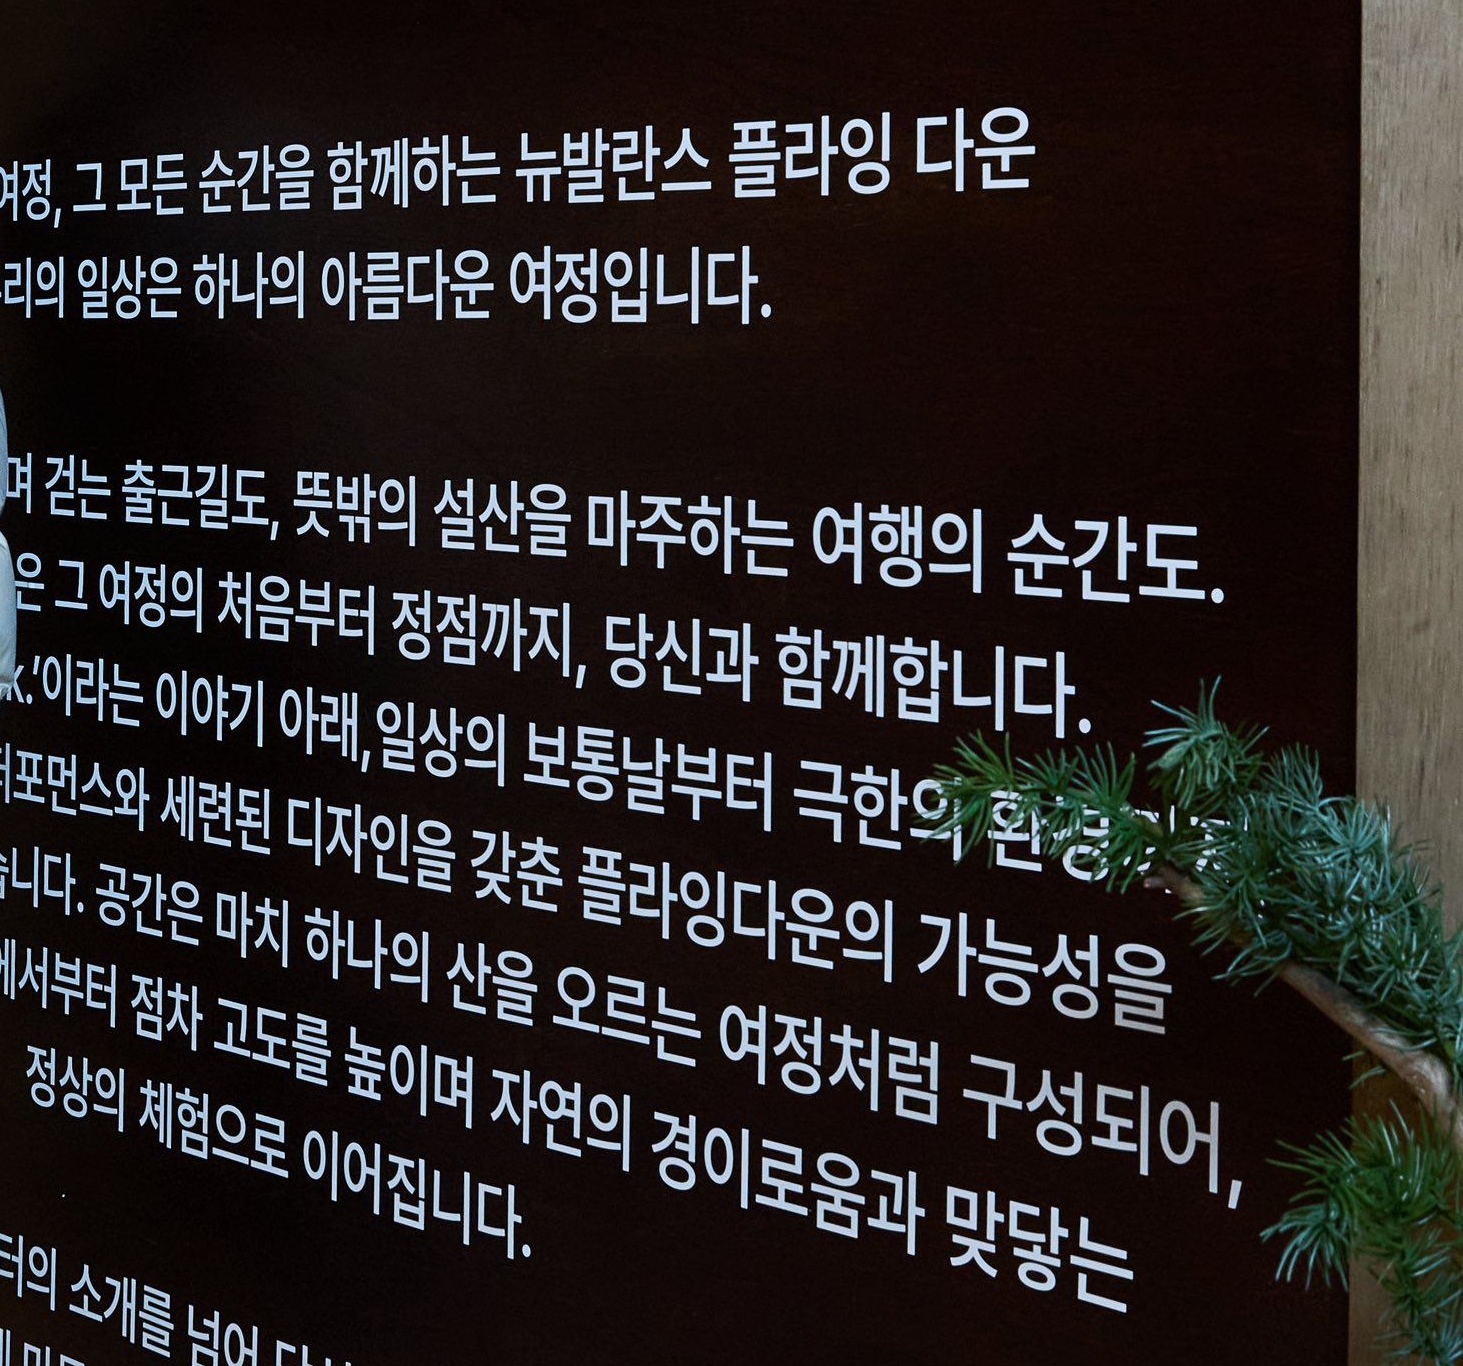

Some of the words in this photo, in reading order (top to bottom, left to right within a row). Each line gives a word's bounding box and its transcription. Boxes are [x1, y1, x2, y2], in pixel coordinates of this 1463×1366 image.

[73, 163, 106, 211] 그
[117, 154, 187, 215] 모든
[199, 144, 314, 213] 순간을
[327, 135, 500, 210] 함께하는
[516, 125, 711, 203] 뉴발란스
[729, 112, 890, 198] 플라잉
[917, 107, 1035, 192] 다운
[78, 256, 181, 319] 일상은
[193, 251, 304, 319] 하나의
[322, 249, 494, 321] 아름다운
[510, 246, 771, 324] 여정입니다.
[45, 455, 111, 519] 걷는
[122, 460, 279, 540] 출근길도,
[294, 471, 415, 546] 뜻밖의
[434, 478, 571, 557] 설산을
[588, 490, 794, 577] 마주하는
[813, 502, 982, 593] 여행의
[1007, 514, 1224, 603] 순간도.
[55, 560, 88, 610] 그
[100, 561, 202, 633] 여정의
[218, 572, 374, 655] 처음부터
[392, 590, 586, 688] 정점까지,
[606, 613, 759, 702] 당신과
[776, 626, 1092, 739] 함께합니다.
[156, 670, 263, 747] 이야기
[524, 722, 772, 832] 보통날부터
[794, 760, 962, 864] 극한의
[160, 776, 270, 855] 세련된
[288, 797, 455, 893] 디자인을
[471, 830, 563, 912] 갖춘
[578, 846, 893, 983] 플라잉다운의
[918, 912, 1172, 1034] 가능성을
[96, 863, 203, 946] 공간은
[217, 891, 288, 968] 마치
[305, 908, 428, 1003] 하나의
[446, 943, 537, 1026] 산을
[553, 967, 701, 1067] 오르는
[720, 1005, 938, 1124] 여정처럼
[963, 1055, 1242, 1209] 구성되어,
[26, 1045, 124, 1132] 정상의
[139, 1079, 288, 1178] 체험으로
[303, 1130, 531, 1259] 이어집니다.
[131, 975, 203, 1051] 점차
[214, 998, 331, 1086] 고도를
[345, 1026, 473, 1129] 높이며
[491, 1069, 630, 1172] 자연의
[652, 1111, 925, 1256] 경이로움과
[946, 1186, 1133, 1313] 맞닿는
[69, 1264, 174, 1358] 소개를
